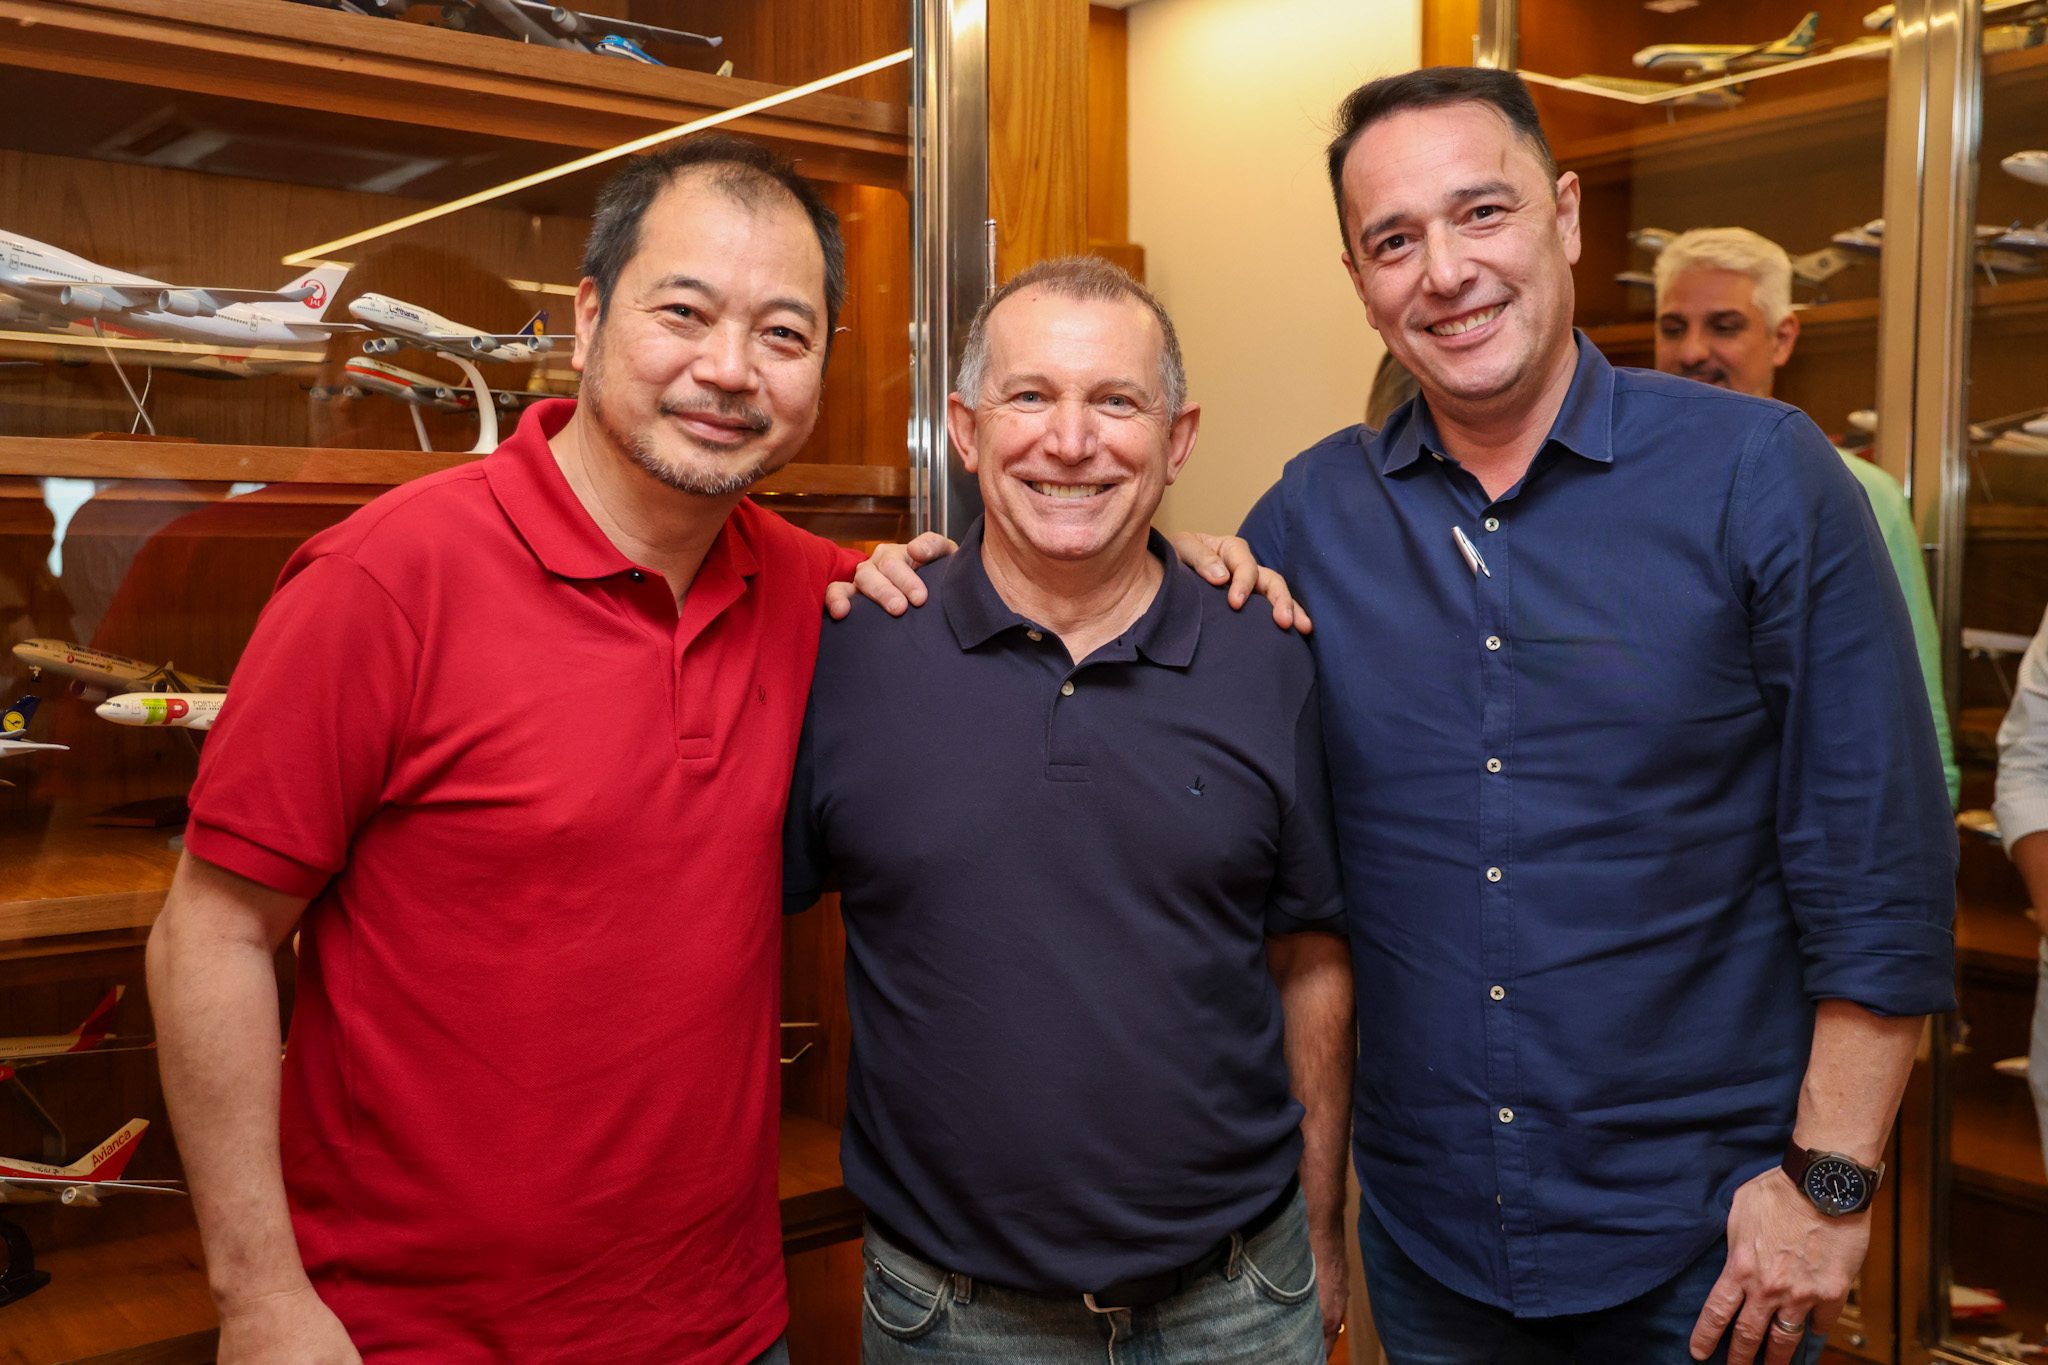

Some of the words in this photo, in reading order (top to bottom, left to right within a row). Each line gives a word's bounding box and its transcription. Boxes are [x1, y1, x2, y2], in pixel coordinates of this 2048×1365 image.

[310, 298, 320, 306] JAL
[192, 700, 223, 708] PORTUG
[91, 1129, 132, 1168] Avianca
